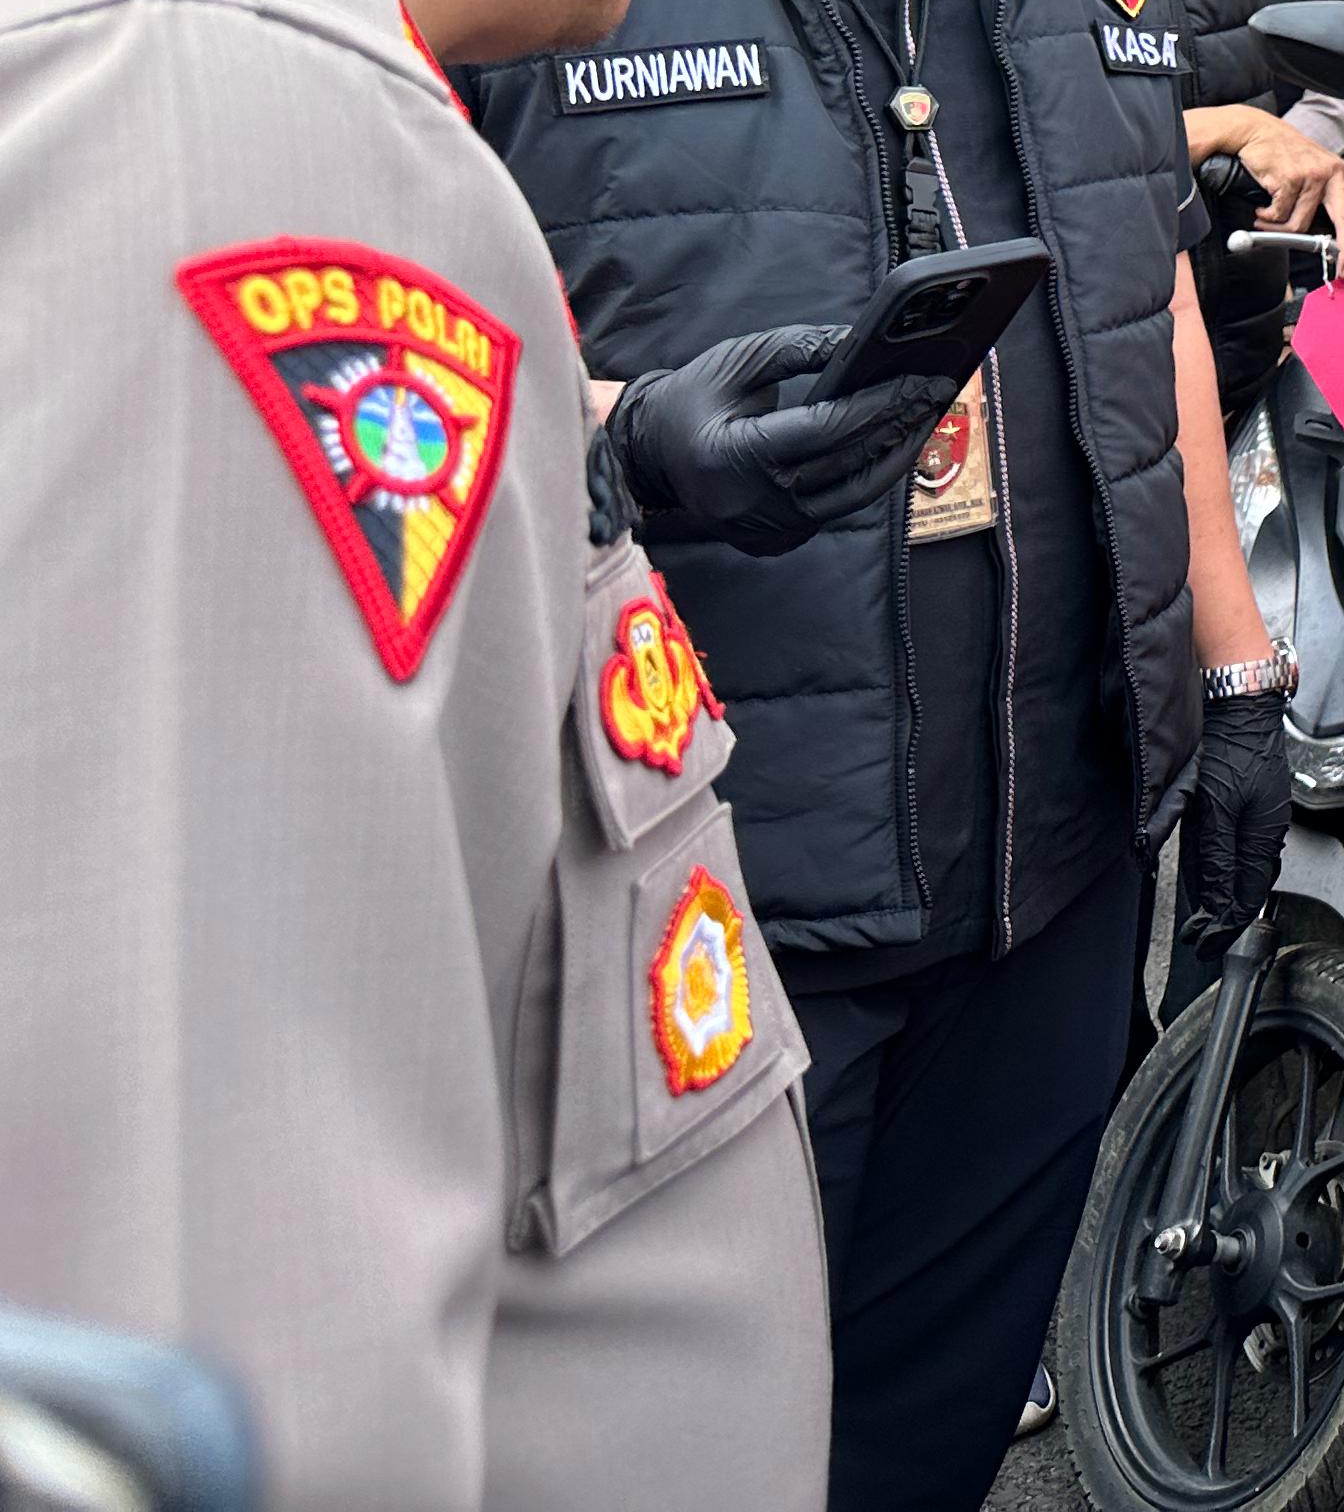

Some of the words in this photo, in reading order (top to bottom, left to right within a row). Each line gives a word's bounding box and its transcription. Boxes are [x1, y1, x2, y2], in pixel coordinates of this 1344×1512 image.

[564, 43, 762, 105] KURNIAWAN
[240, 266, 360, 334] OPS
[377, 276, 492, 377] POLRI
